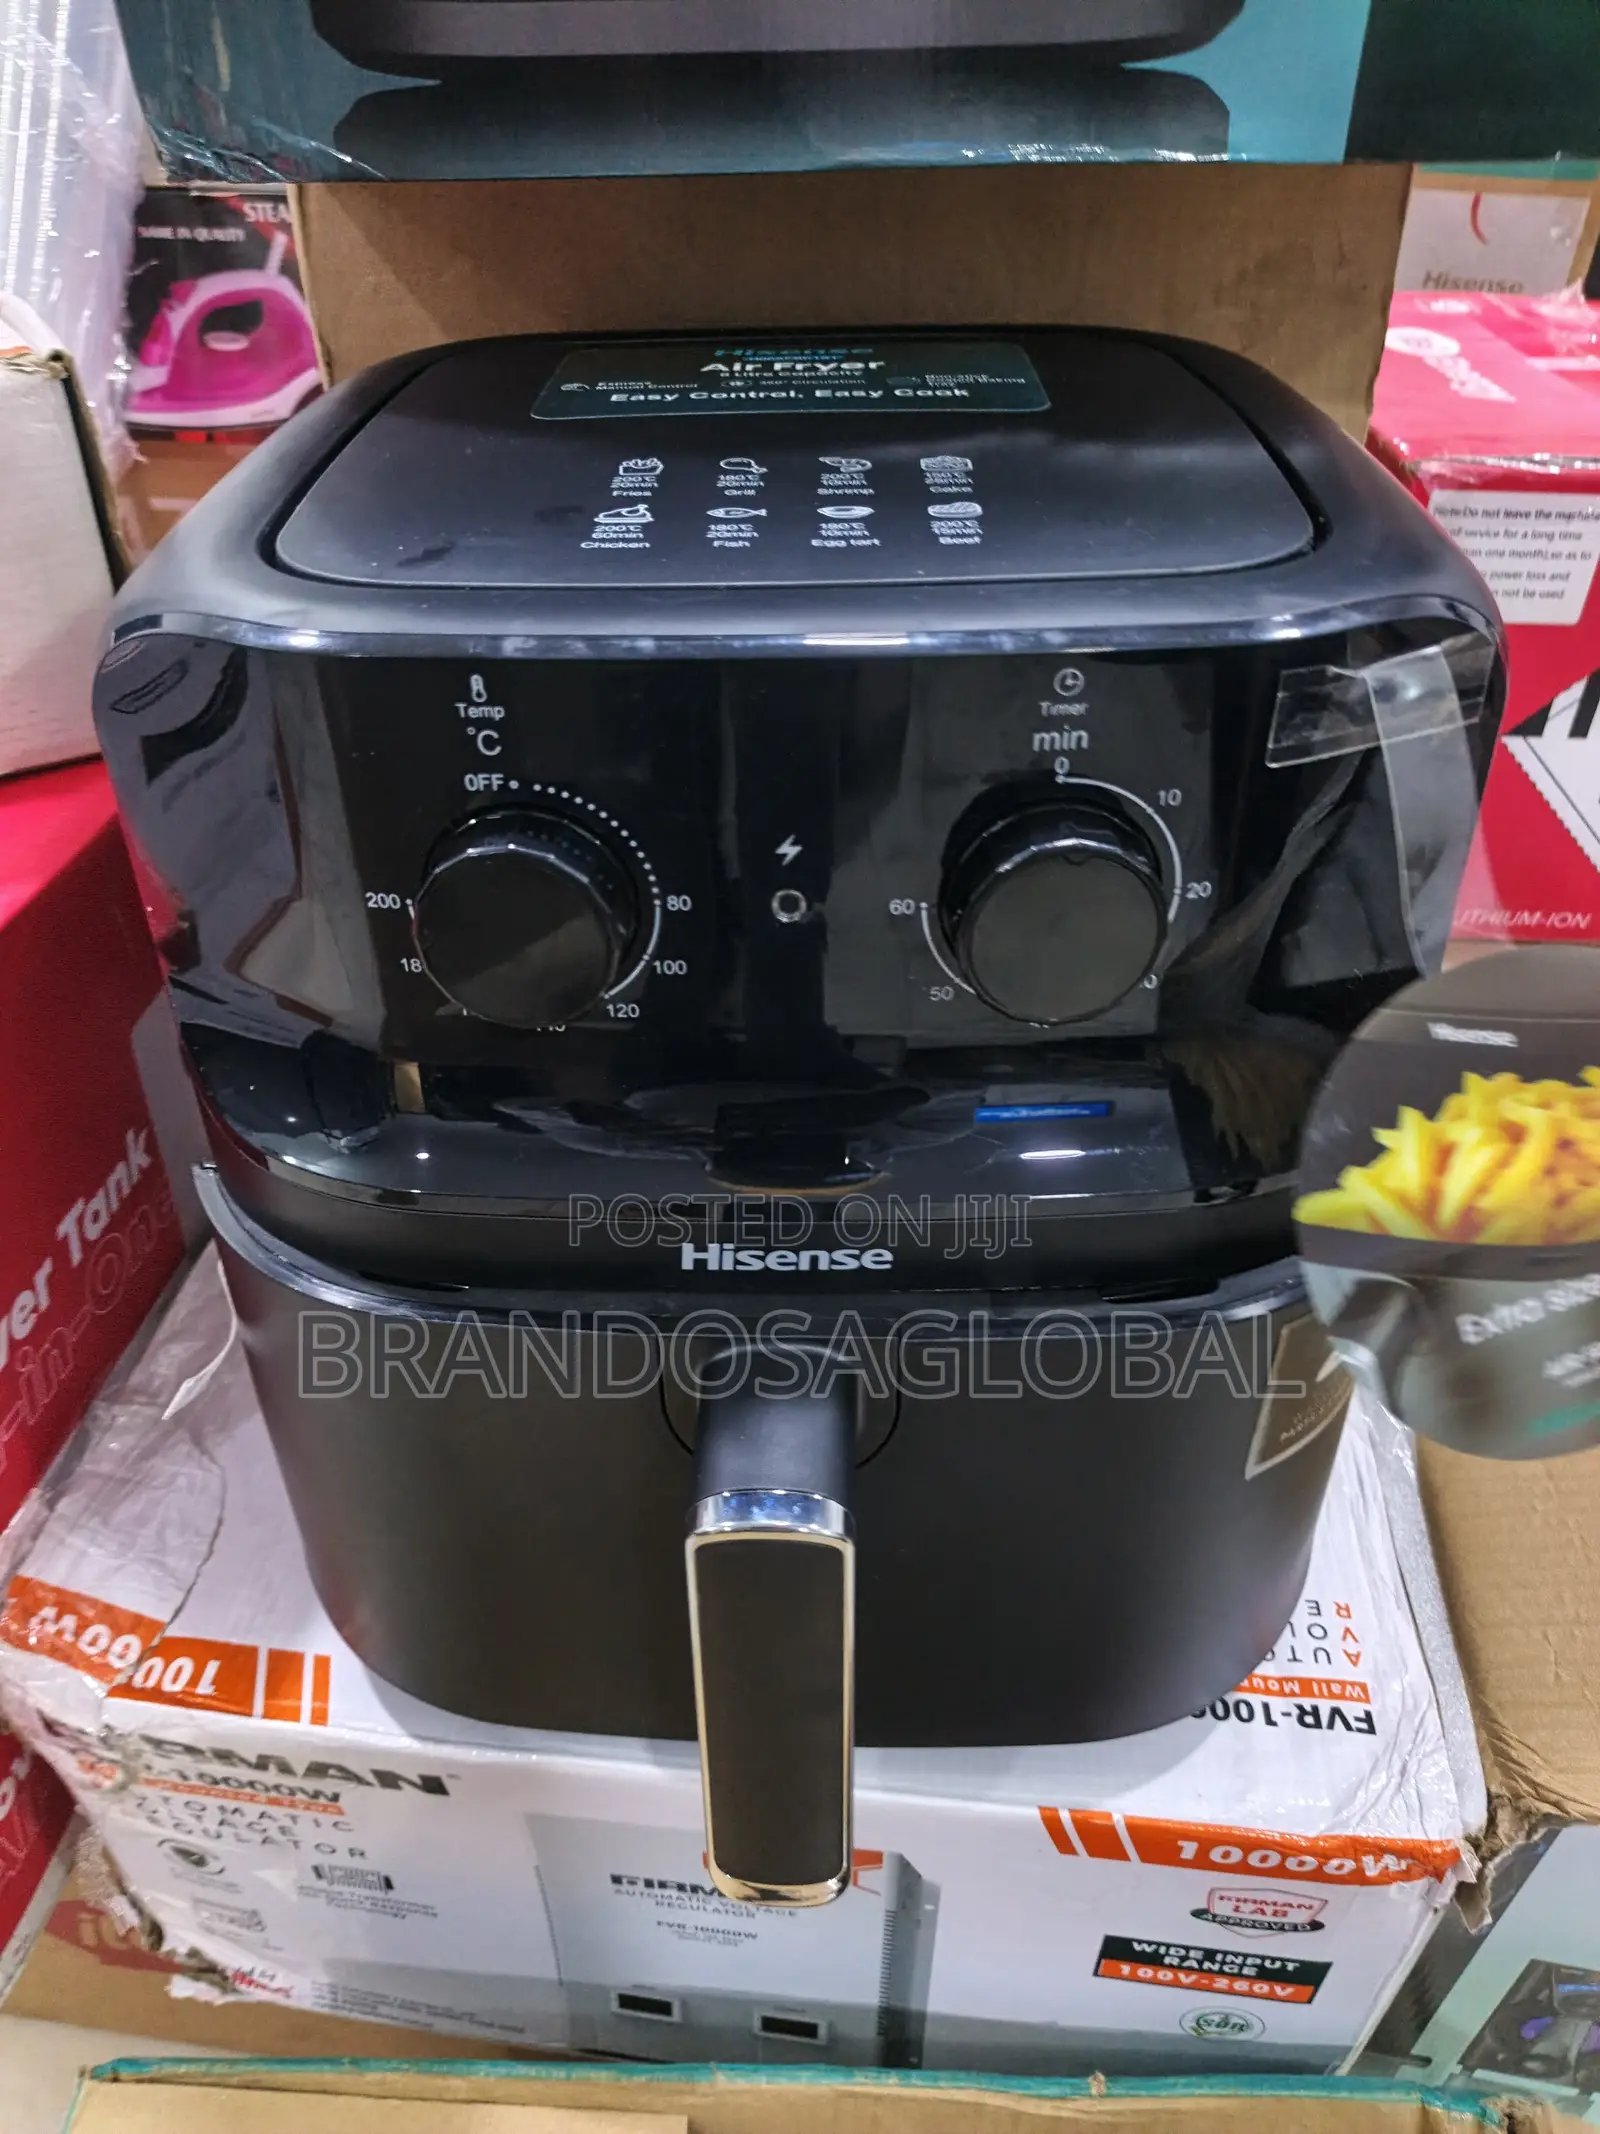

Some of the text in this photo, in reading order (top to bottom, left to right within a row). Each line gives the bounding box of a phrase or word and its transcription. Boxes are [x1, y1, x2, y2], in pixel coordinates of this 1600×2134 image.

[243, 202, 290, 223] STEA
[1422, 269, 1525, 294] Hisense
[700, 360, 885, 372] Air Fryer
[610, 393, 680, 402] Easy
[815, 388, 884, 399] Easy
[893, 387, 970, 398] Cook
[724, 488, 757, 497] Grill
[817, 488, 875, 496] Shrimp
[1481, 507, 1500, 519] not
[1503, 508, 1531, 520] leave
[1534, 508, 1552, 520] the
[706, 531, 760, 539] 20min
[811, 538, 848, 548] Egg
[1465, 530, 1500, 538] service
[1503, 528, 1518, 539] for
[1521, 530, 1528, 539] a
[1530, 529, 1556, 543] long
[1558, 530, 1583, 541] time
[713, 540, 751, 548] Fish
[1565, 551, 1577, 560] as
[1579, 551, 1592, 561] to
[1489, 569, 1572, 582] power loss and
[1523, 588, 1536, 599] be
[1538, 590, 1566, 600] used
[455, 703, 505, 720] Temp
[1039, 701, 1090, 717] Timer
[1033, 725, 1090, 753] min
[464, 773, 505, 792] OFF
[1157, 788, 1182, 807] 10
[1185, 881, 1213, 899] 20
[365, 892, 401, 910] 200
[666, 895, 692, 912] 80
[889, 898, 915, 916] 60
[1453, 908, 1593, 930] ITHIUM-ION
[400, 958, 423, 974] 18
[653, 960, 688, 976] 100
[929, 986, 955, 1002] 50
[606, 1003, 640, 1019] 120
[0, 1127, 151, 1372] er Tank
[681, 1243, 893, 1272] Hisense
[27, 1605, 222, 1696] 10000W
[1312, 1681, 1366, 1699] Wall
[610, 1873, 727, 1898] FIRM
[614, 1888, 711, 1905] AUTOMATIC
[1218, 1894, 1315, 1910] FIRMAN
[655, 1900, 757, 1919] REGULATOR
[1232, 1904, 1289, 1918] LAB
[1200, 1911, 1312, 1932] APPROVED
[1131, 1941, 1300, 1972] WIDE INPUT
[1163, 1955, 1260, 1976] RANGE
[1119, 1964, 1296, 1997] 100V-260V
